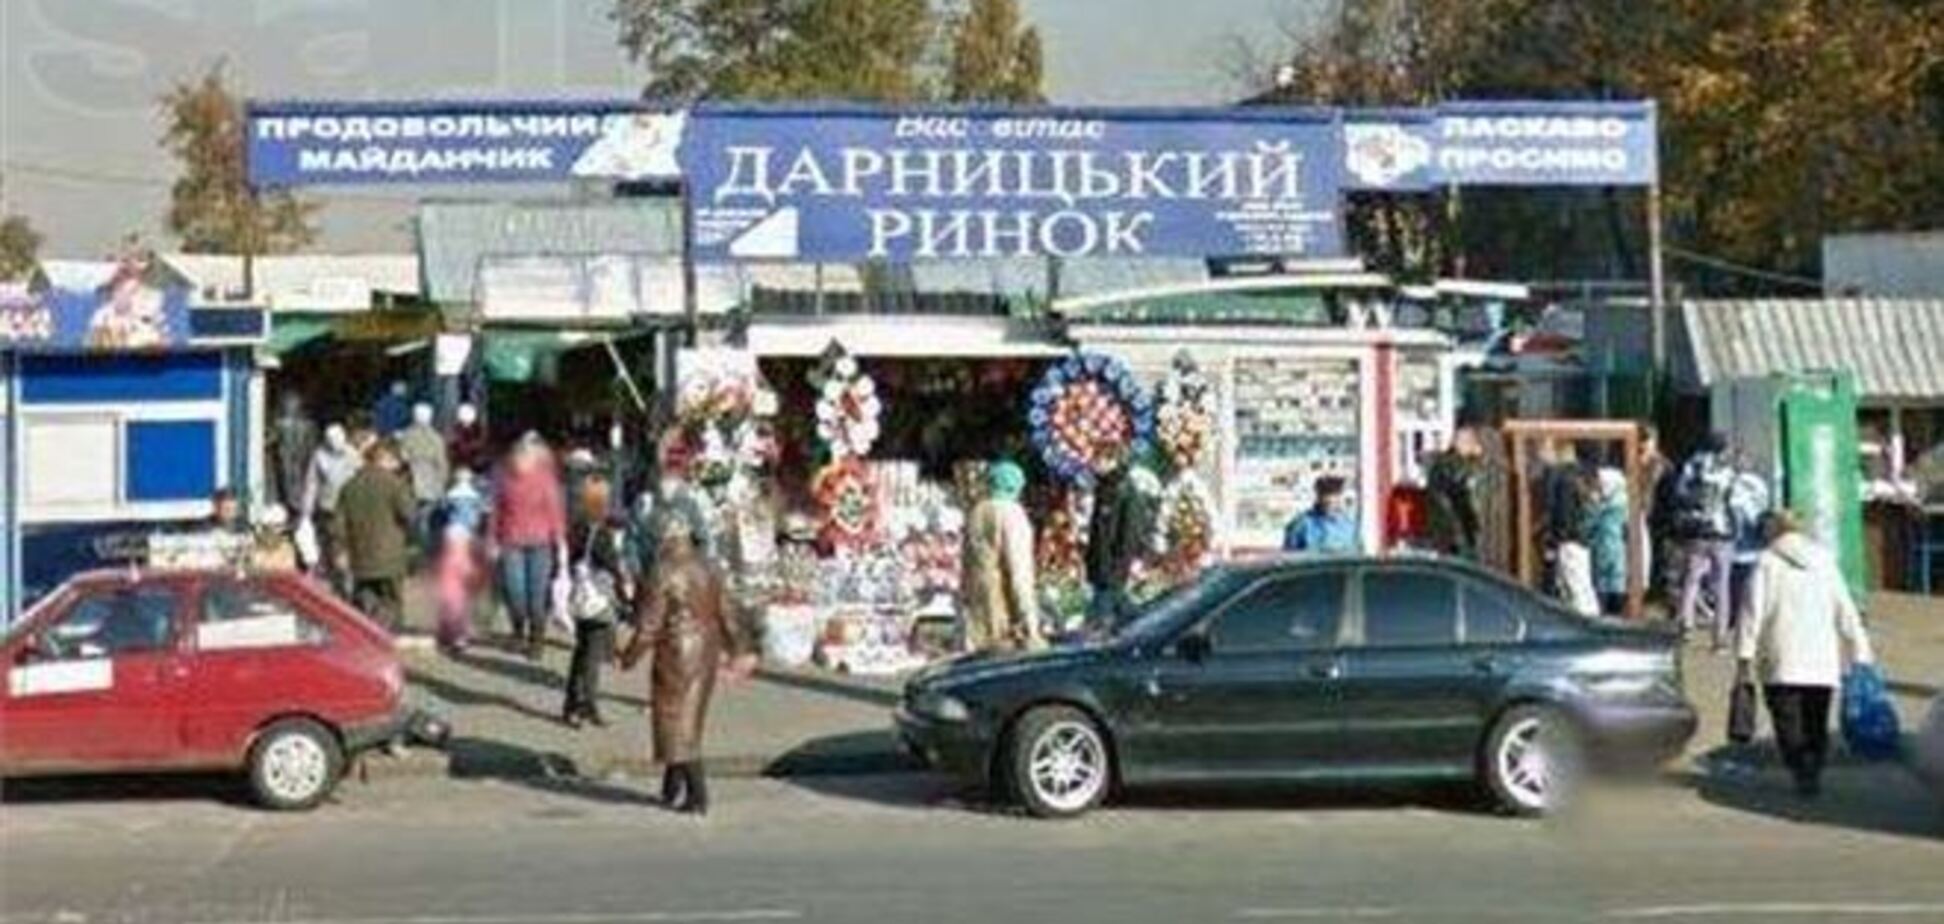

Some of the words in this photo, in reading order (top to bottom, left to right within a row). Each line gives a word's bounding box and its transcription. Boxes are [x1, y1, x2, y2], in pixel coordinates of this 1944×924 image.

[299, 146, 556, 175] МАЙДАНЧИК
[713, 139, 1304, 208] ДАРНИЦЬКИЙ
[1438, 146, 1628, 172] ПРОСИМО
[865, 208, 1156, 259] РИНОК
